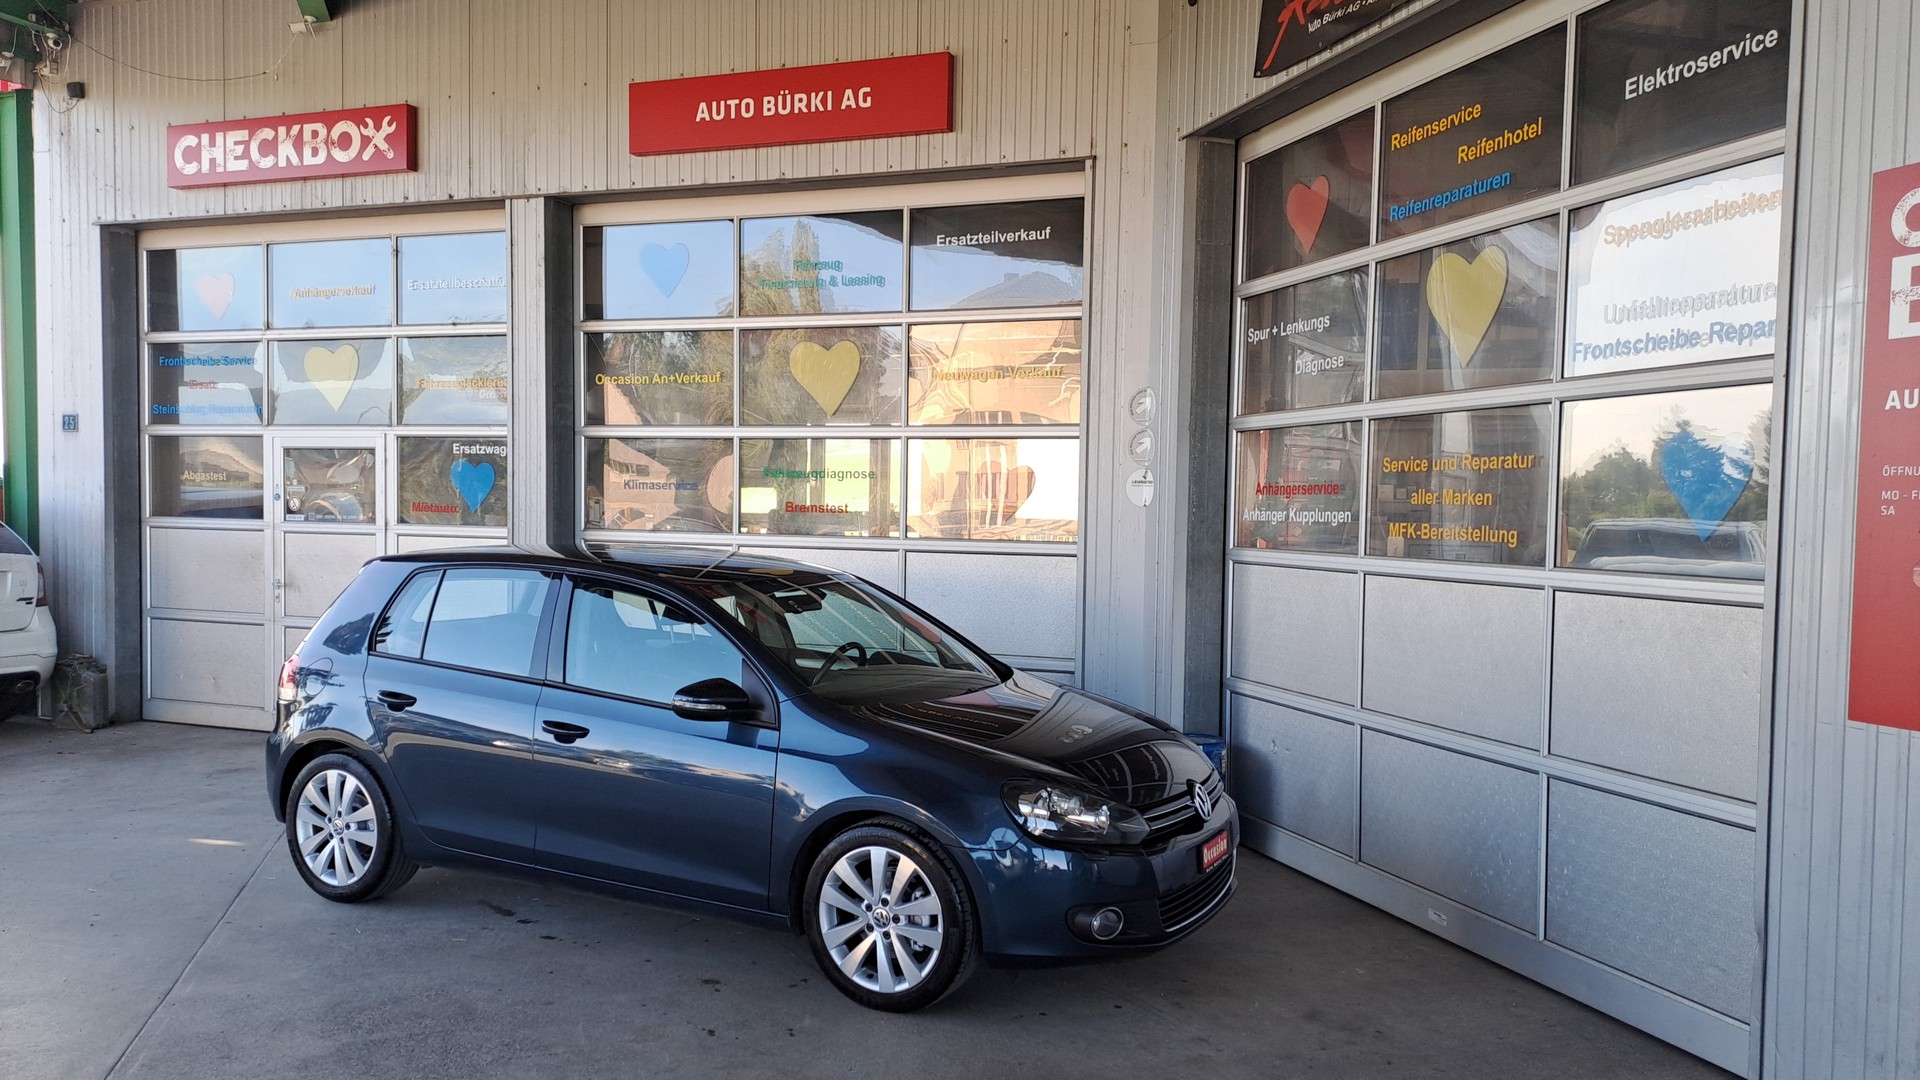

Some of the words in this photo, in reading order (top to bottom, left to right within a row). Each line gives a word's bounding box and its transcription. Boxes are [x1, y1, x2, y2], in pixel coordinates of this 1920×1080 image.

[1308, 18, 1321, 34] Auto
[1323, 8, 1346, 24] Bürki
[1345, 2, 1361, 14] AG
[1624, 29, 1779, 100] Elektroservice
[695, 98, 755, 122] AUTO
[762, 90, 833, 117] BÜRKI
[840, 87, 872, 109] AG
[1390, 103, 1482, 151] Reifenservice
[174, 115, 397, 175] CHECKBOX
[1457, 116, 1543, 164] Reifenhotel
[1389, 171, 1511, 222] Reifenreparaturen
[936, 226, 1051, 247] Ersatzteilverkauf
[828, 275, 838, 287] &
[1247, 328, 1270, 345] Spur
[1272, 325, 1278, 336] +
[1280, 315, 1330, 336] Lenkungs
[1572, 328, 1704, 362] Frontscheibe
[933, 367, 1005, 382] Neuwagen
[1008, 365, 1064, 380] Verkauf
[1295, 355, 1344, 375] Diagnose
[595, 373, 649, 385] Occasion
[652, 371, 722, 385] An+Verkauf
[452, 443, 507, 457] Ersatzwag
[1382, 456, 1429, 473] Service
[1432, 455, 1457, 471] und
[1461, 451, 1535, 474] Reparatur
[183, 470, 227, 482] Abgastest
[763, 466, 876, 481] Fahrzeugdiagnose
[623, 479, 698, 491] Klimaservice
[1255, 480, 1342, 499] Anhängerservice
[1881, 490, 1899, 500] MO
[1410, 489, 1438, 506] aller
[1442, 488, 1492, 506] Marken
[411, 501, 459, 514] Mietauto
[785, 501, 849, 514] Bremstest
[1242, 505, 1287, 525] Anhänger
[1288, 507, 1352, 527] Kupplungen
[1880, 505, 1896, 516] SA
[1388, 522, 1519, 548] MFK-Bereitstellung
